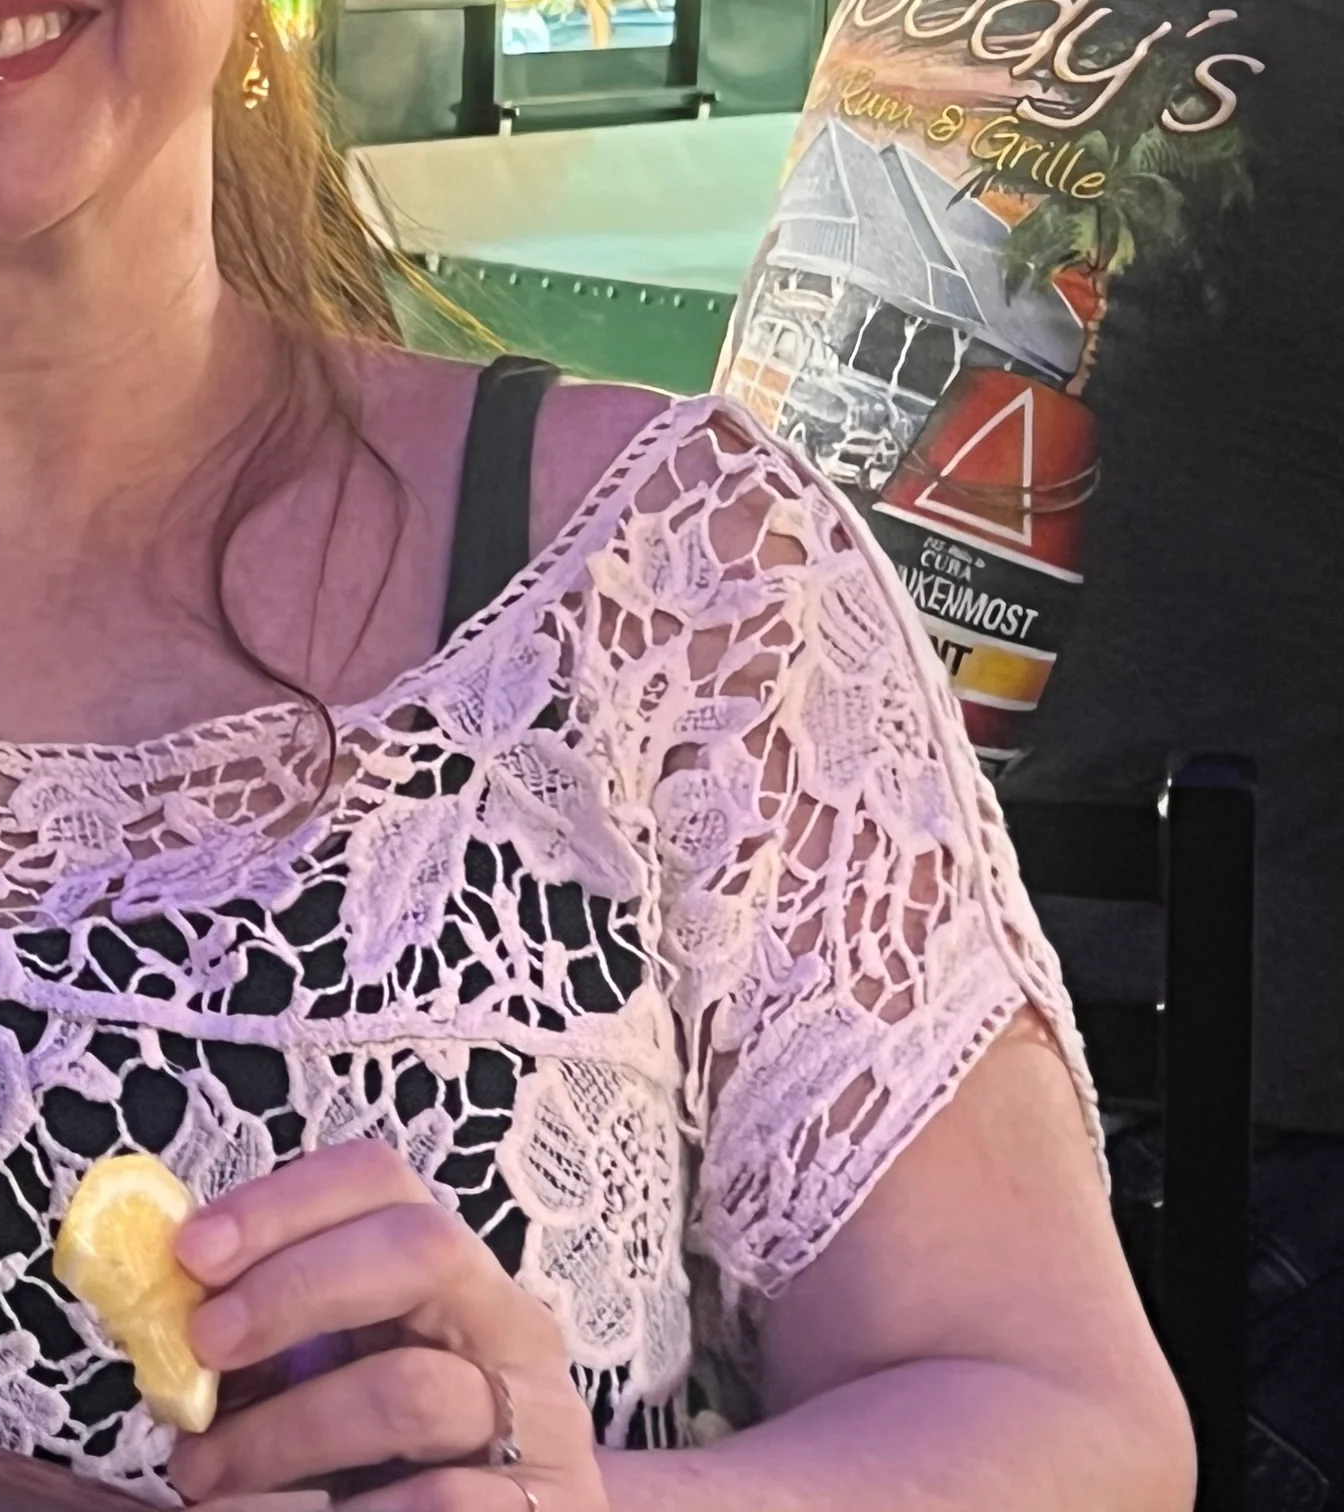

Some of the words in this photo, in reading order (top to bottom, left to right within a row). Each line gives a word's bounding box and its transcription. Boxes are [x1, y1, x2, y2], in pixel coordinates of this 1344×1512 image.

[831, 67, 914, 129] Rum
[970, 114, 1109, 200] Grille
[921, 549, 972, 582] CUBA
